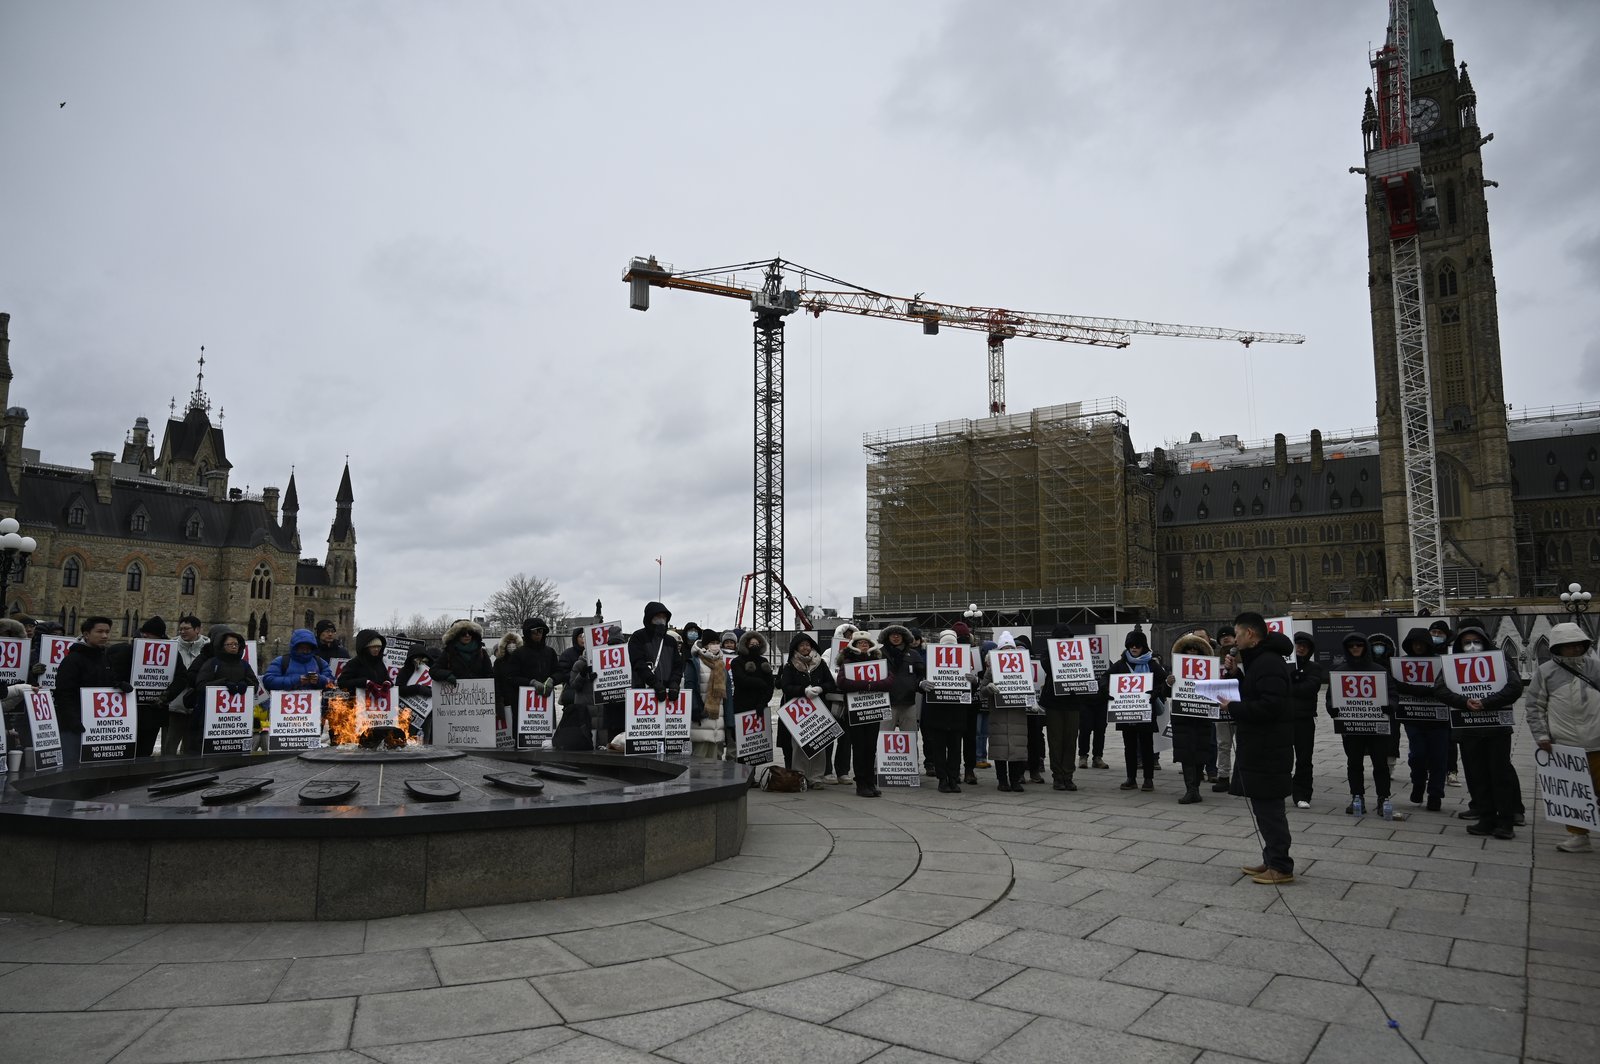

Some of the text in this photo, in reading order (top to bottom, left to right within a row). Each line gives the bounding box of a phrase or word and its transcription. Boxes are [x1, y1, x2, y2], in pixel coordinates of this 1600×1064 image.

[147, 643, 167, 666] 16
[603, 648, 622, 669] 19
[940, 648, 958, 667] 11
[1060, 641, 1081, 661] 34
[858, 664, 877, 680] 19
[1001, 653, 1022, 673] 23
[1185, 659, 1206, 679] 13
[1406, 662, 1428, 682] 37
[1458, 657, 1490, 683] 70
[1121, 676, 1142, 692] 32
[1345, 676, 1372, 697] 36
[33, 694, 51, 720] 36
[96, 693, 124, 718] 38
[219, 690, 242, 713] 34
[284, 694, 309, 713] 35
[529, 691, 544, 711] 11
[636, 694, 656, 715] 25
[788, 698, 814, 723] 28
[437, 708, 446, 716] Nos
[800, 714, 818, 729] MONTHS
[744, 715, 763, 734] 23
[799, 715, 826, 737] WAITING FOR
[800, 718, 832, 745] IRCC RESPONSE
[749, 743, 770, 753] RESPONSE
[888, 735, 906, 753] 19
[1535, 748, 1588, 772] CANADA
[1539, 774, 1592, 800] WHAT ARE
[1544, 799, 1597, 826] YOU DOING?
